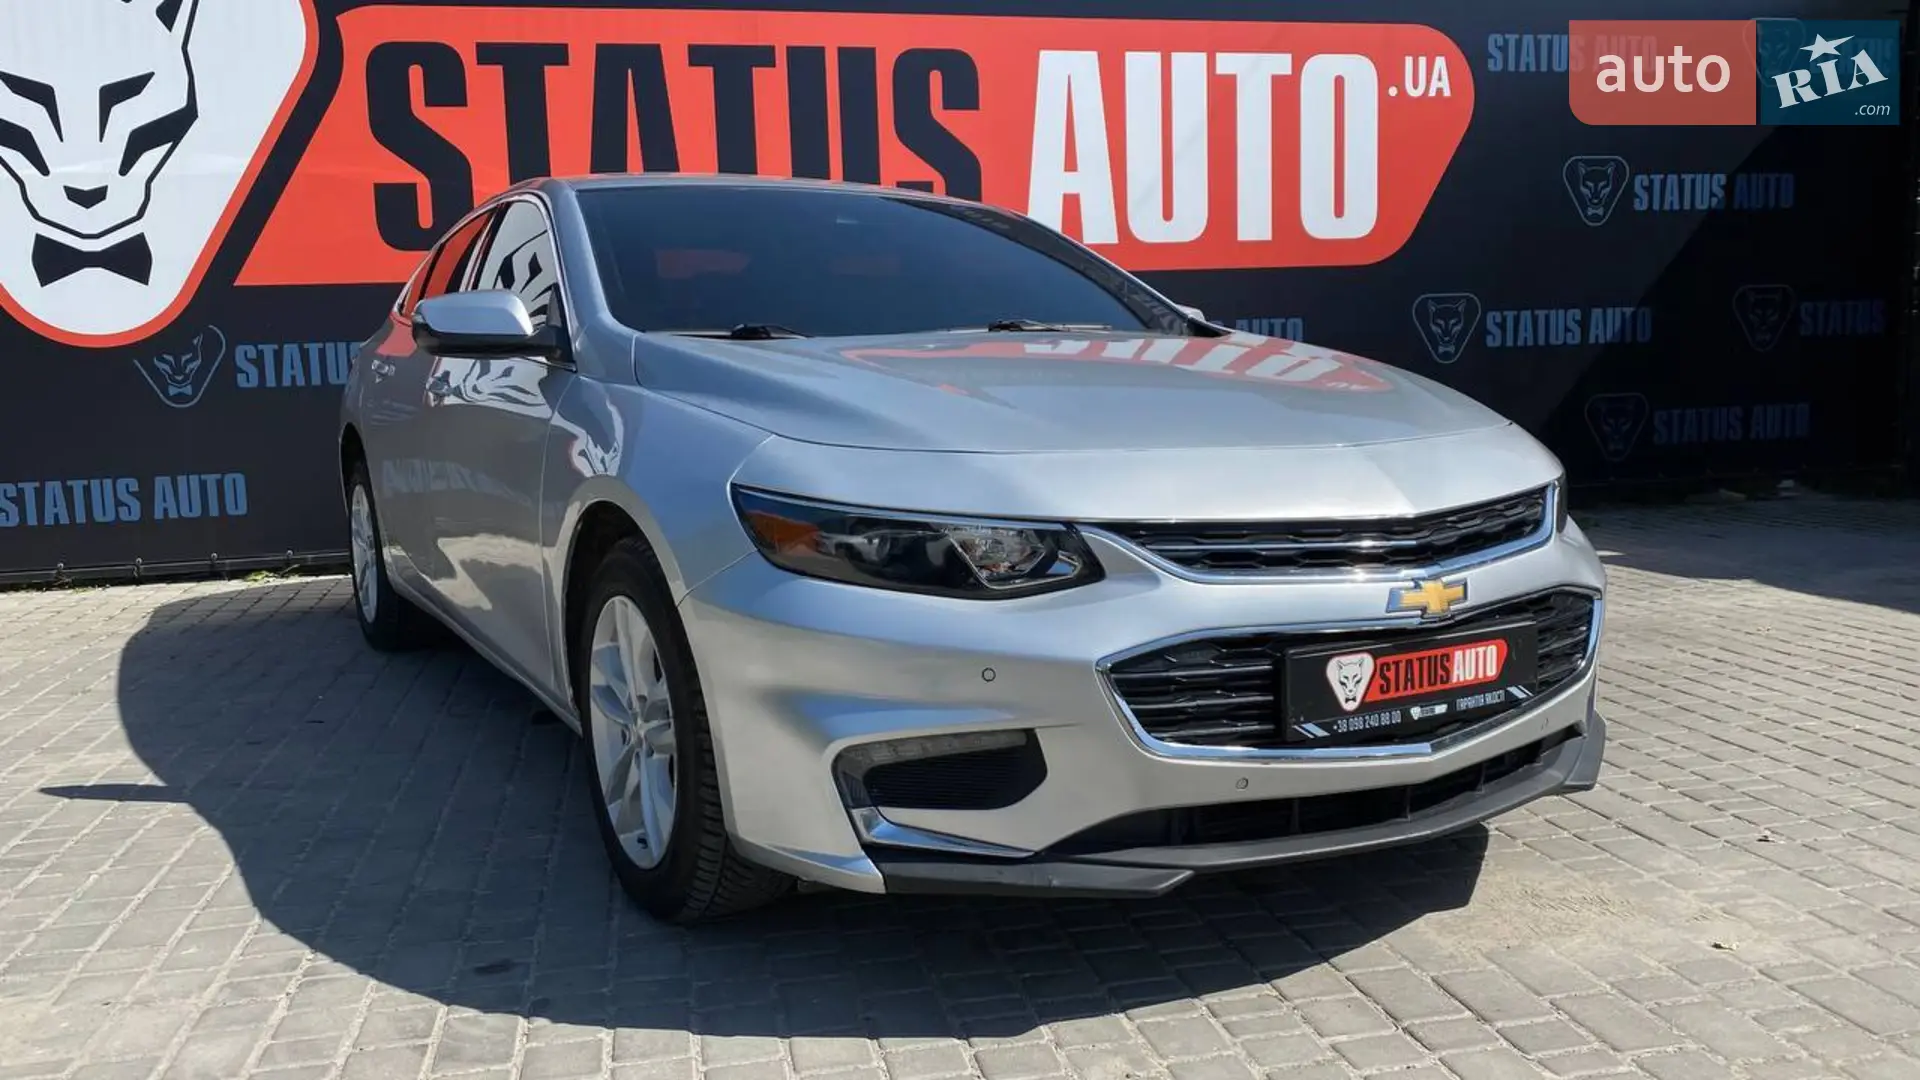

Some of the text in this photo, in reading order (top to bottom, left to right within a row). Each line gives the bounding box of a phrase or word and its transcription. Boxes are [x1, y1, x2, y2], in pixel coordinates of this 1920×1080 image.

[366, 41, 983, 251] STATUS
[1027, 50, 1379, 244] AUTO
[1633, 172, 1796, 212] STATUS AUTO
[1486, 307, 1653, 348] STATUS AUTO
[1652, 405, 1744, 447] STATUS
[0, 473, 248, 528] STATUS AUTO
